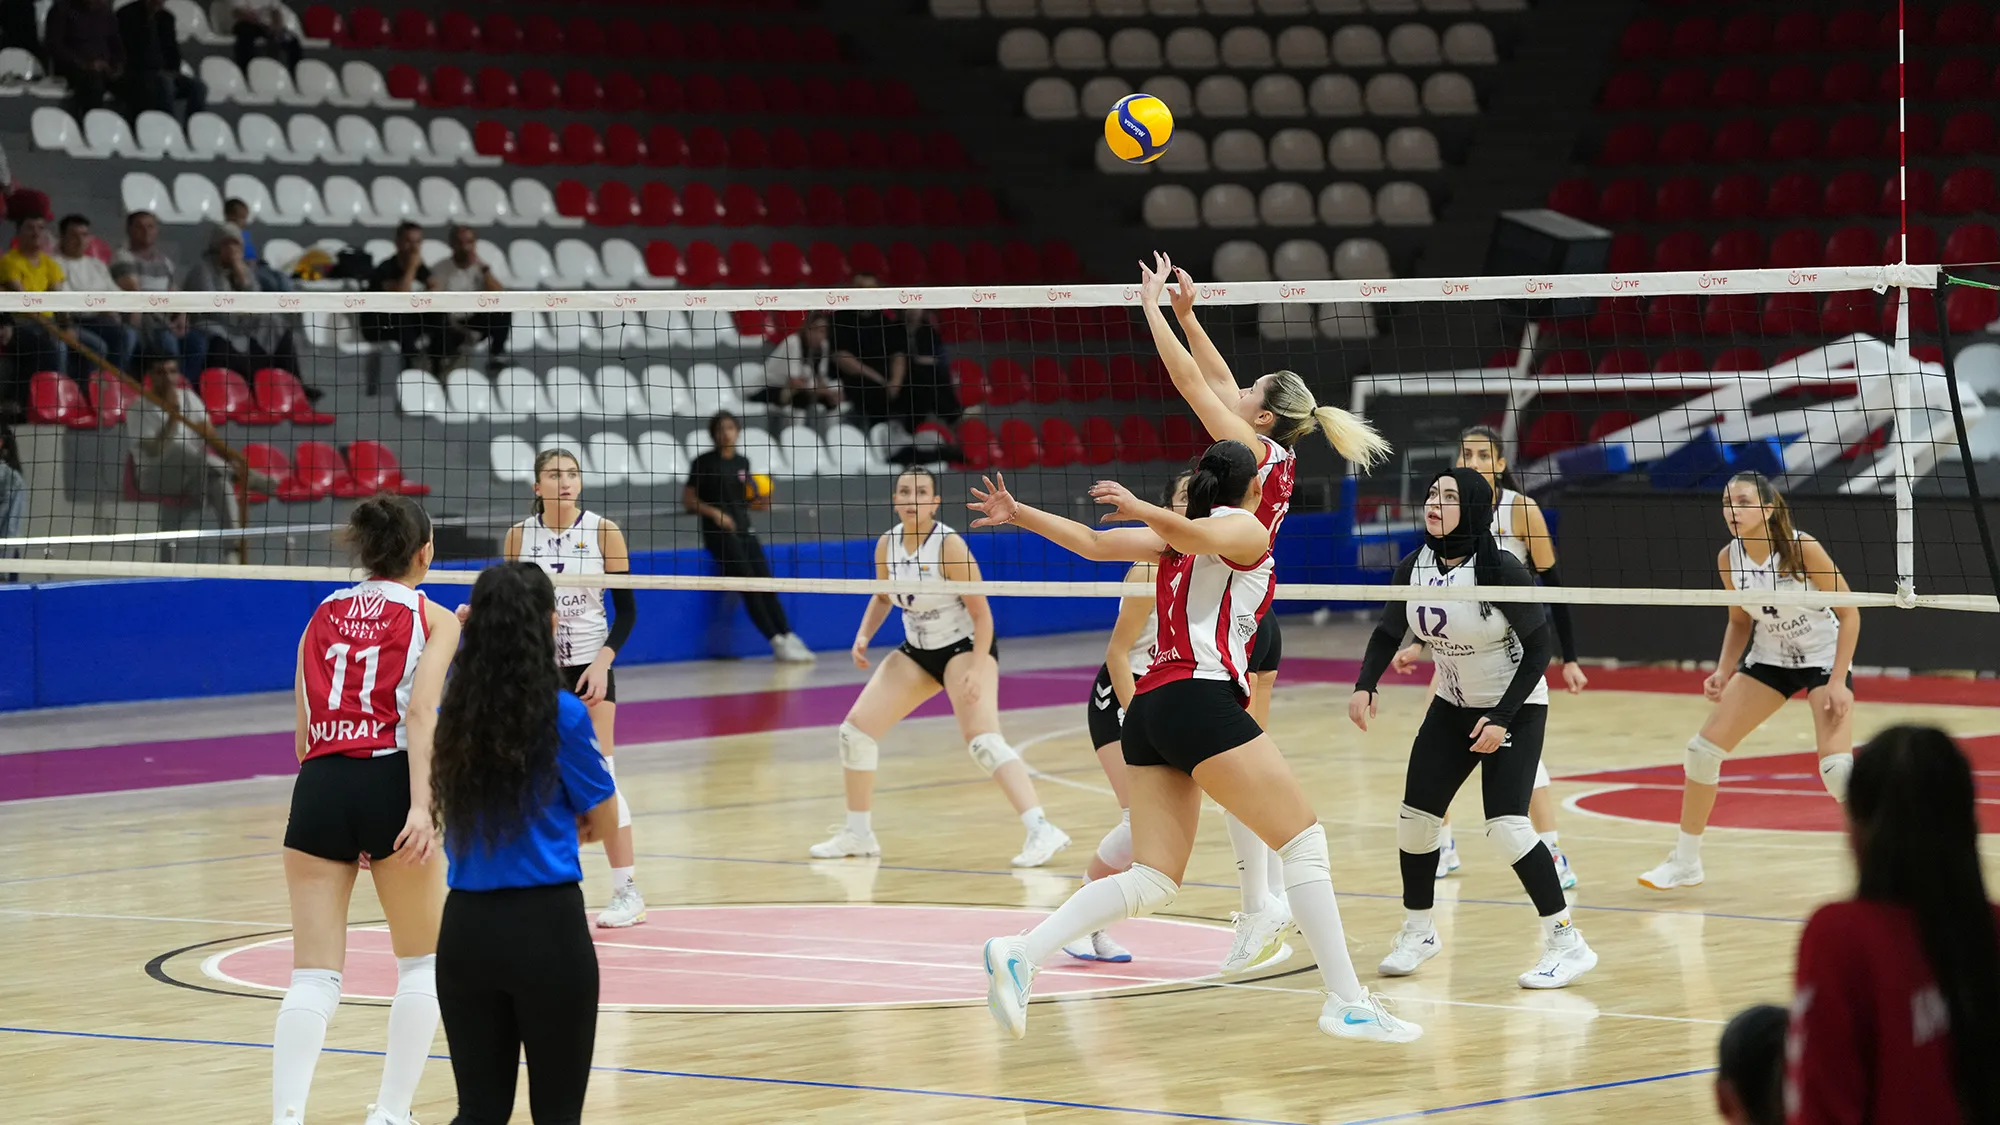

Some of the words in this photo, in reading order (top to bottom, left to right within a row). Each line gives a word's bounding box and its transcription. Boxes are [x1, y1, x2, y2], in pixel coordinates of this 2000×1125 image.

[1711, 277, 1728, 285] TVF
[1801, 274, 1818, 282] TVF
[1454, 284, 1469, 292] TVF
[1538, 282, 1553, 290] TVF
[1624, 280, 1639, 288] TVF
[1372, 286, 1387, 294] TVF
[1058, 291, 1072, 299] TVF
[554, 595, 587, 607] YGAR
[1416, 605, 1449, 640] 12
[1764, 614, 1808, 633] UYGAR
[339, 627, 377, 640] OTEL
[324, 642, 381, 714] 11
[310, 719, 386, 744] NURAY
